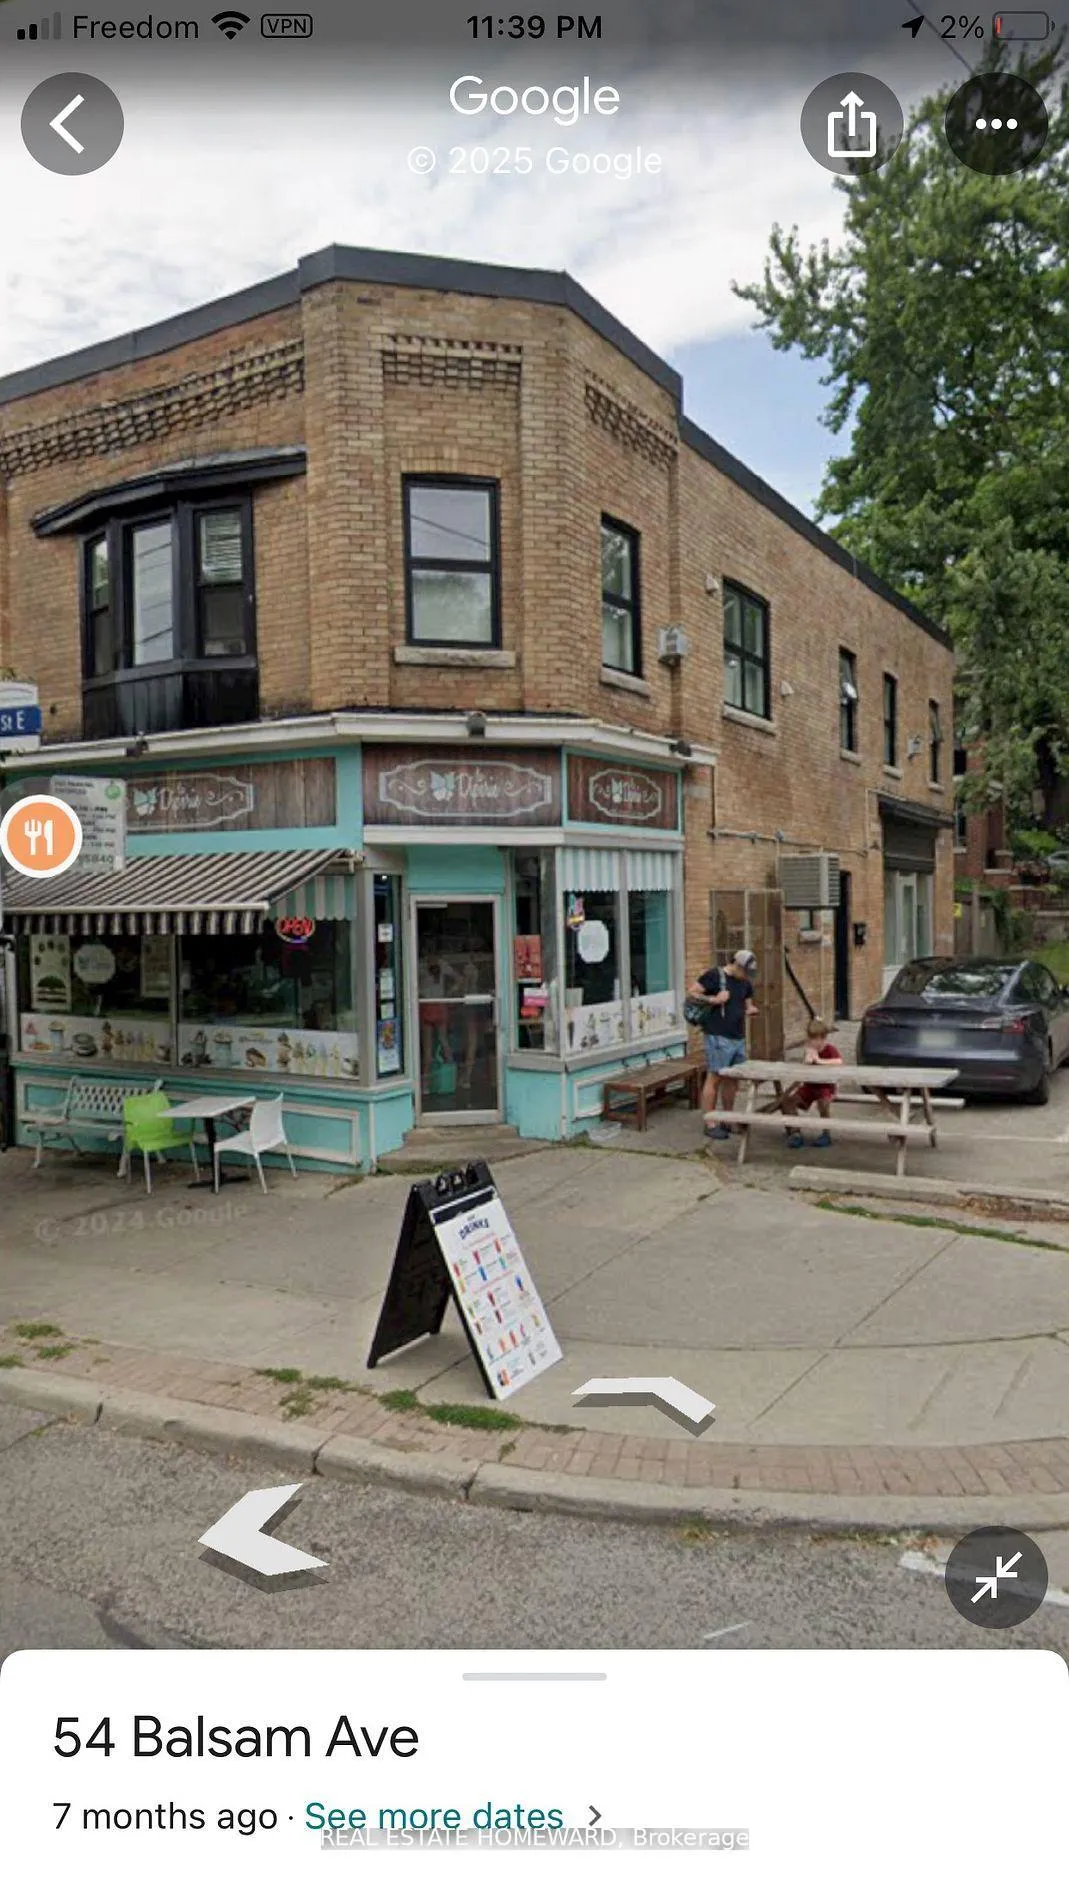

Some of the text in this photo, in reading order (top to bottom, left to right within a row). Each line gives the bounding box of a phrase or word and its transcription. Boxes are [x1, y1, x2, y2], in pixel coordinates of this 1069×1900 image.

[0, 710, 25, 733] St E
[279, 916, 314, 937] OPEN
